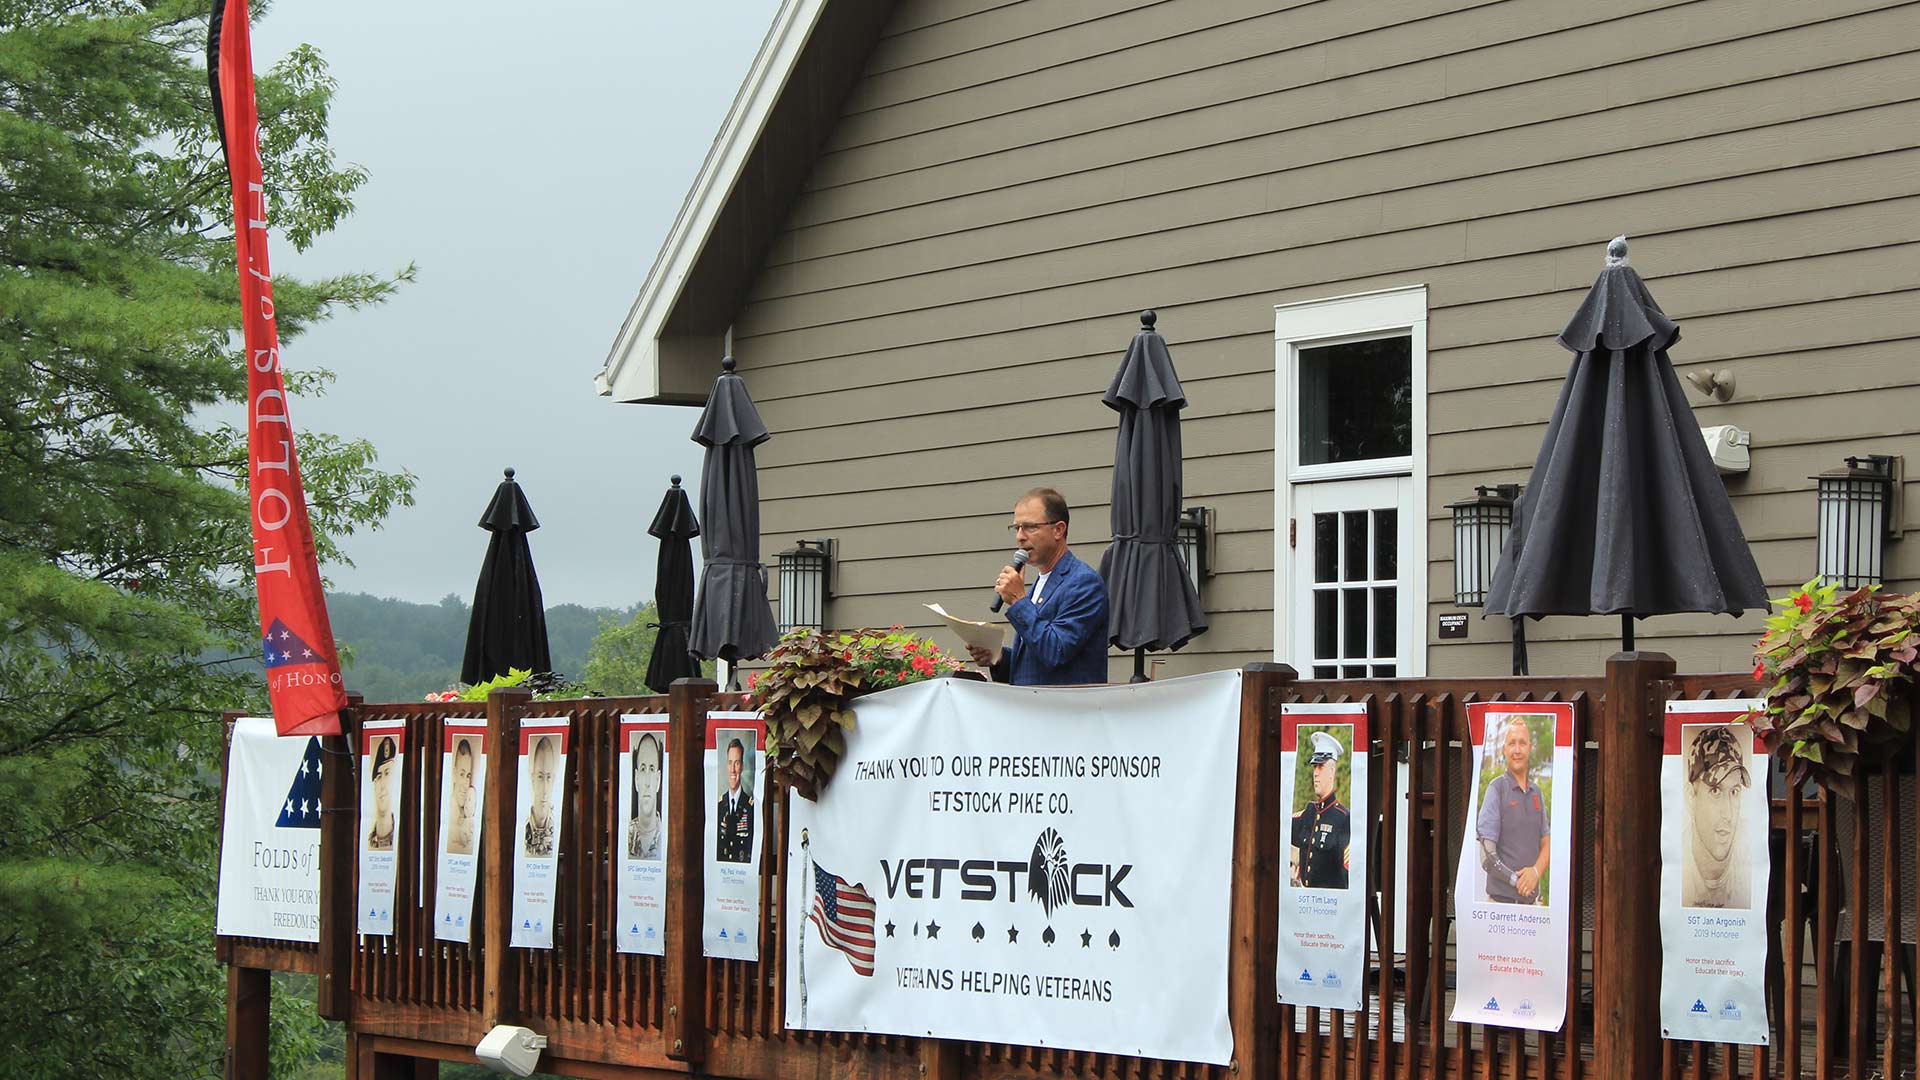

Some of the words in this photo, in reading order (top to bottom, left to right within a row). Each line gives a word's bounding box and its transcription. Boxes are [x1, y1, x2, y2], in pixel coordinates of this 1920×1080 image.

[254, 348, 291, 578] FOLDS
[272, 674, 283, 693] of
[286, 671, 342, 688] HONO
[855, 759, 895, 780] THANK
[899, 756, 928, 778] YOU
[930, 755, 945, 777] TO
[951, 755, 982, 777] OUR
[988, 756, 1085, 778] PRESENTING
[1091, 755, 1161, 778] SPONSOR
[928, 790, 1003, 813] ETSTOCK
[1008, 792, 1044, 814] PIKE
[1048, 792, 1073, 814] CO.
[253, 841, 298, 870] FOLDS
[302, 843, 315, 877] of
[253, 886, 280, 902] THANK
[281, 887, 297, 904] YOU
[299, 889, 313, 904] FOR
[1298, 895, 1309, 903] SGT
[1311, 895, 1322, 904] Tim
[1323, 896, 1338, 906] Lang
[1298, 905, 1311, 914] 2017
[1313, 907, 1337, 916] Honoree
[1472, 910, 1487, 920] SGT
[1490, 912, 1517, 923] Garrett
[1518, 914, 1551, 925] Anderson
[273, 912, 308, 929] FREEDOM
[1687, 916, 1700, 925] SGT
[1702, 917, 1715, 926] Jan
[1715, 917, 1746, 928] Argonish
[1488, 924, 1505, 935] 2018
[1507, 926, 1537, 937] Honoree
[1693, 929, 1709, 938] 2019
[1710, 929, 1739, 939] Honoree
[1477, 953, 1496, 961] Honor
[1496, 954, 1510, 963] their
[1685, 956, 1700, 964] Honor
[1701, 957, 1714, 965] their
[1490, 963, 1512, 972] Educate
[961, 970, 1030, 996] HELPING
[1036, 975, 1112, 1003] VETERANS
